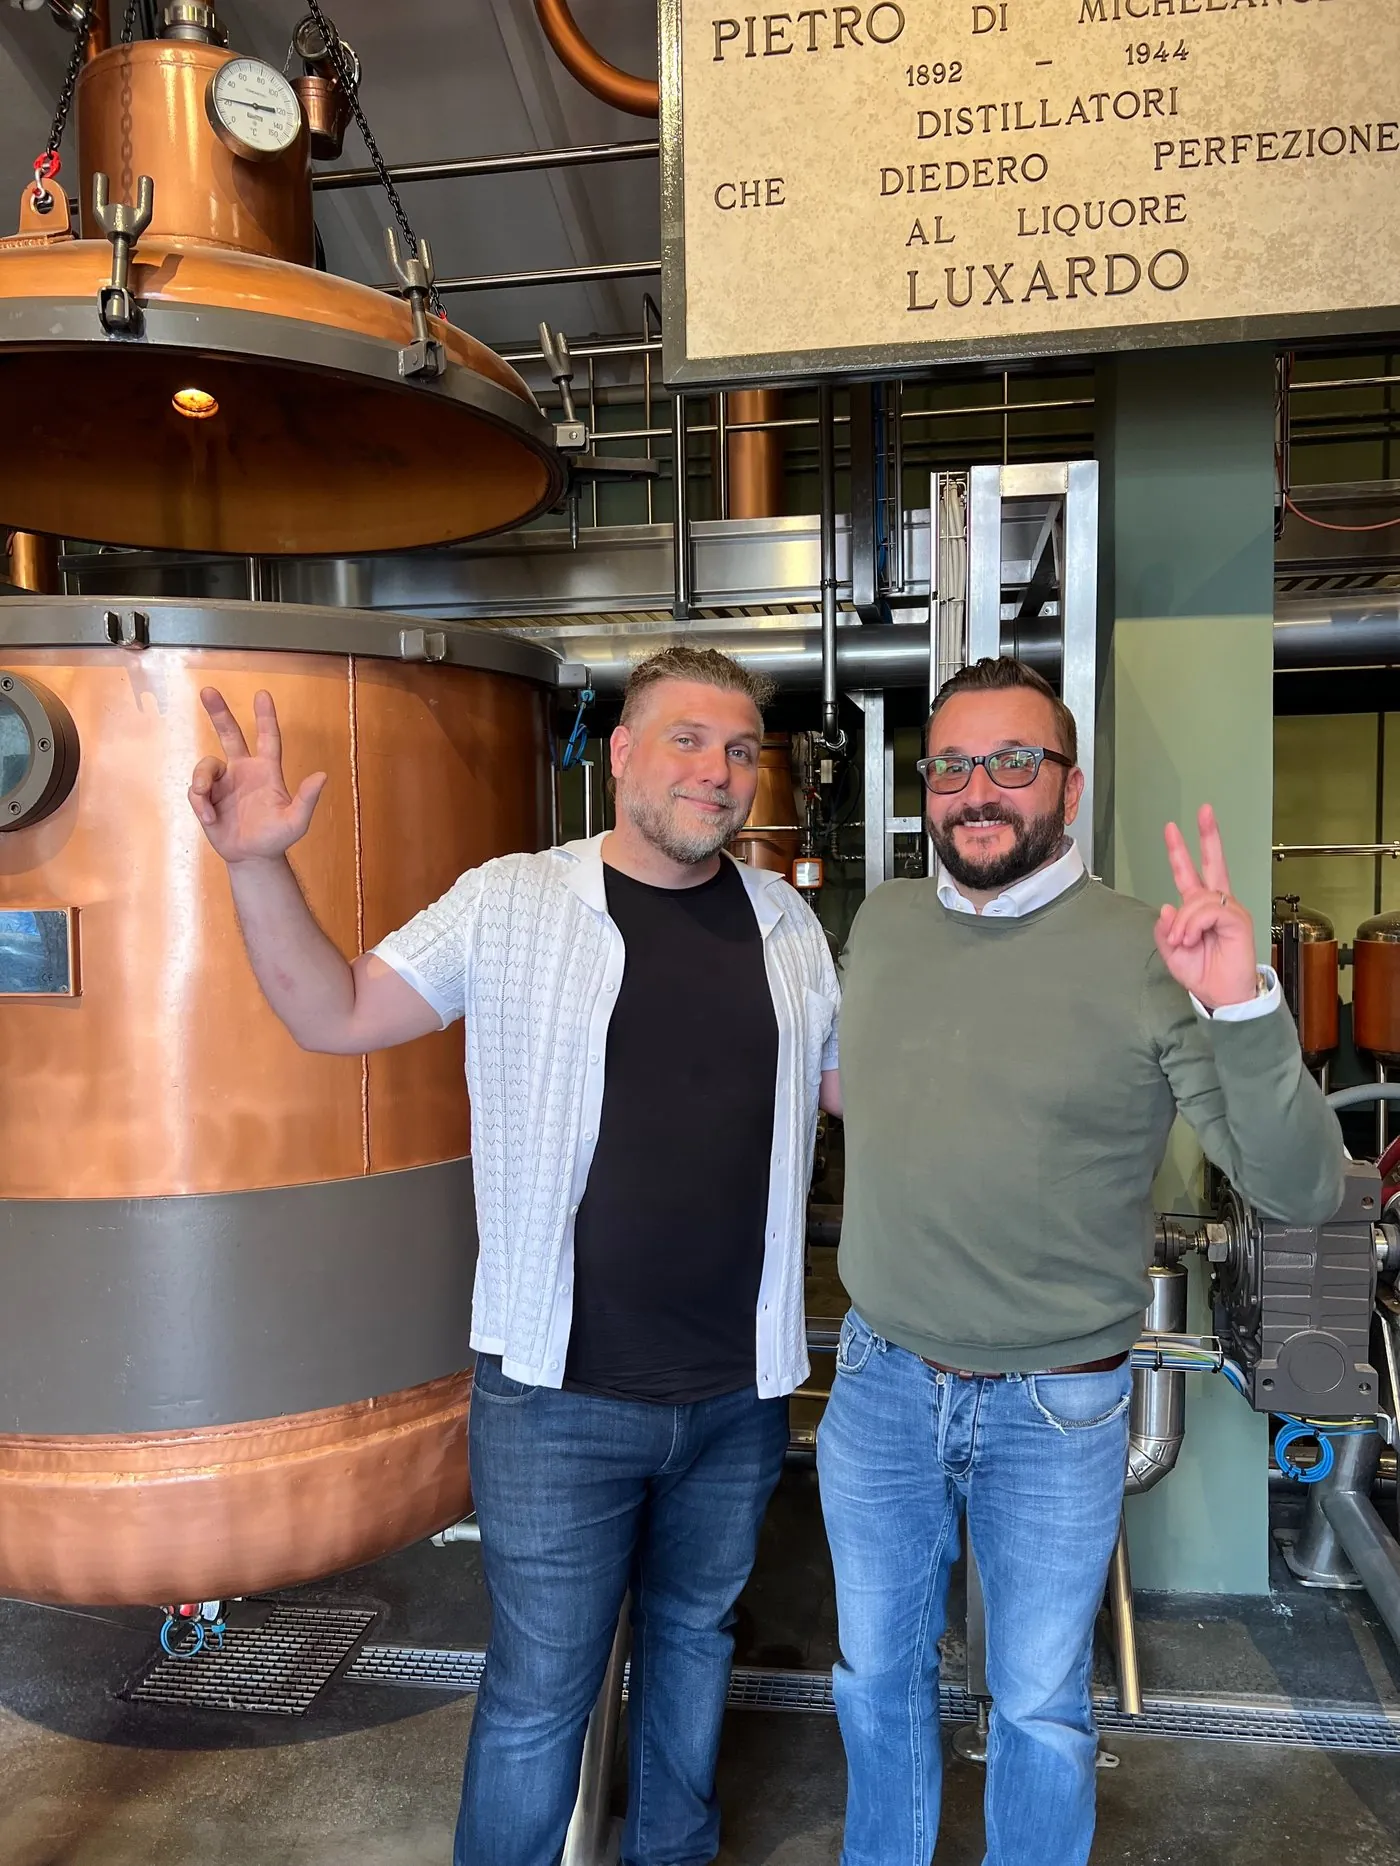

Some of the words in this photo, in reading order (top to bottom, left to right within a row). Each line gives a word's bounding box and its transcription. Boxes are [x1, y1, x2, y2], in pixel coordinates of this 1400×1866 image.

[711, 1, 906, 62] PIETRO
[971, 3, 1008, 34] DI
[238, 73, 247, 81] 60
[906, 60, 963, 87] 1892
[1125, 38, 1190, 66] 1944
[268, 88, 279, 97] 100
[276, 107, 286, 116] 120
[916, 86, 1178, 140] DISTILLATORI
[268, 129, 279, 138] 150
[273, 122, 284, 131] 140
[714, 177, 786, 210] CHE
[879, 153, 1049, 197] DIEDERO
[1153, 121, 1400, 171] PERFEZIONE
[905, 215, 956, 247] AL
[1017, 193, 1187, 238] LIQUORE
[906, 248, 1190, 312] LUXARDO
